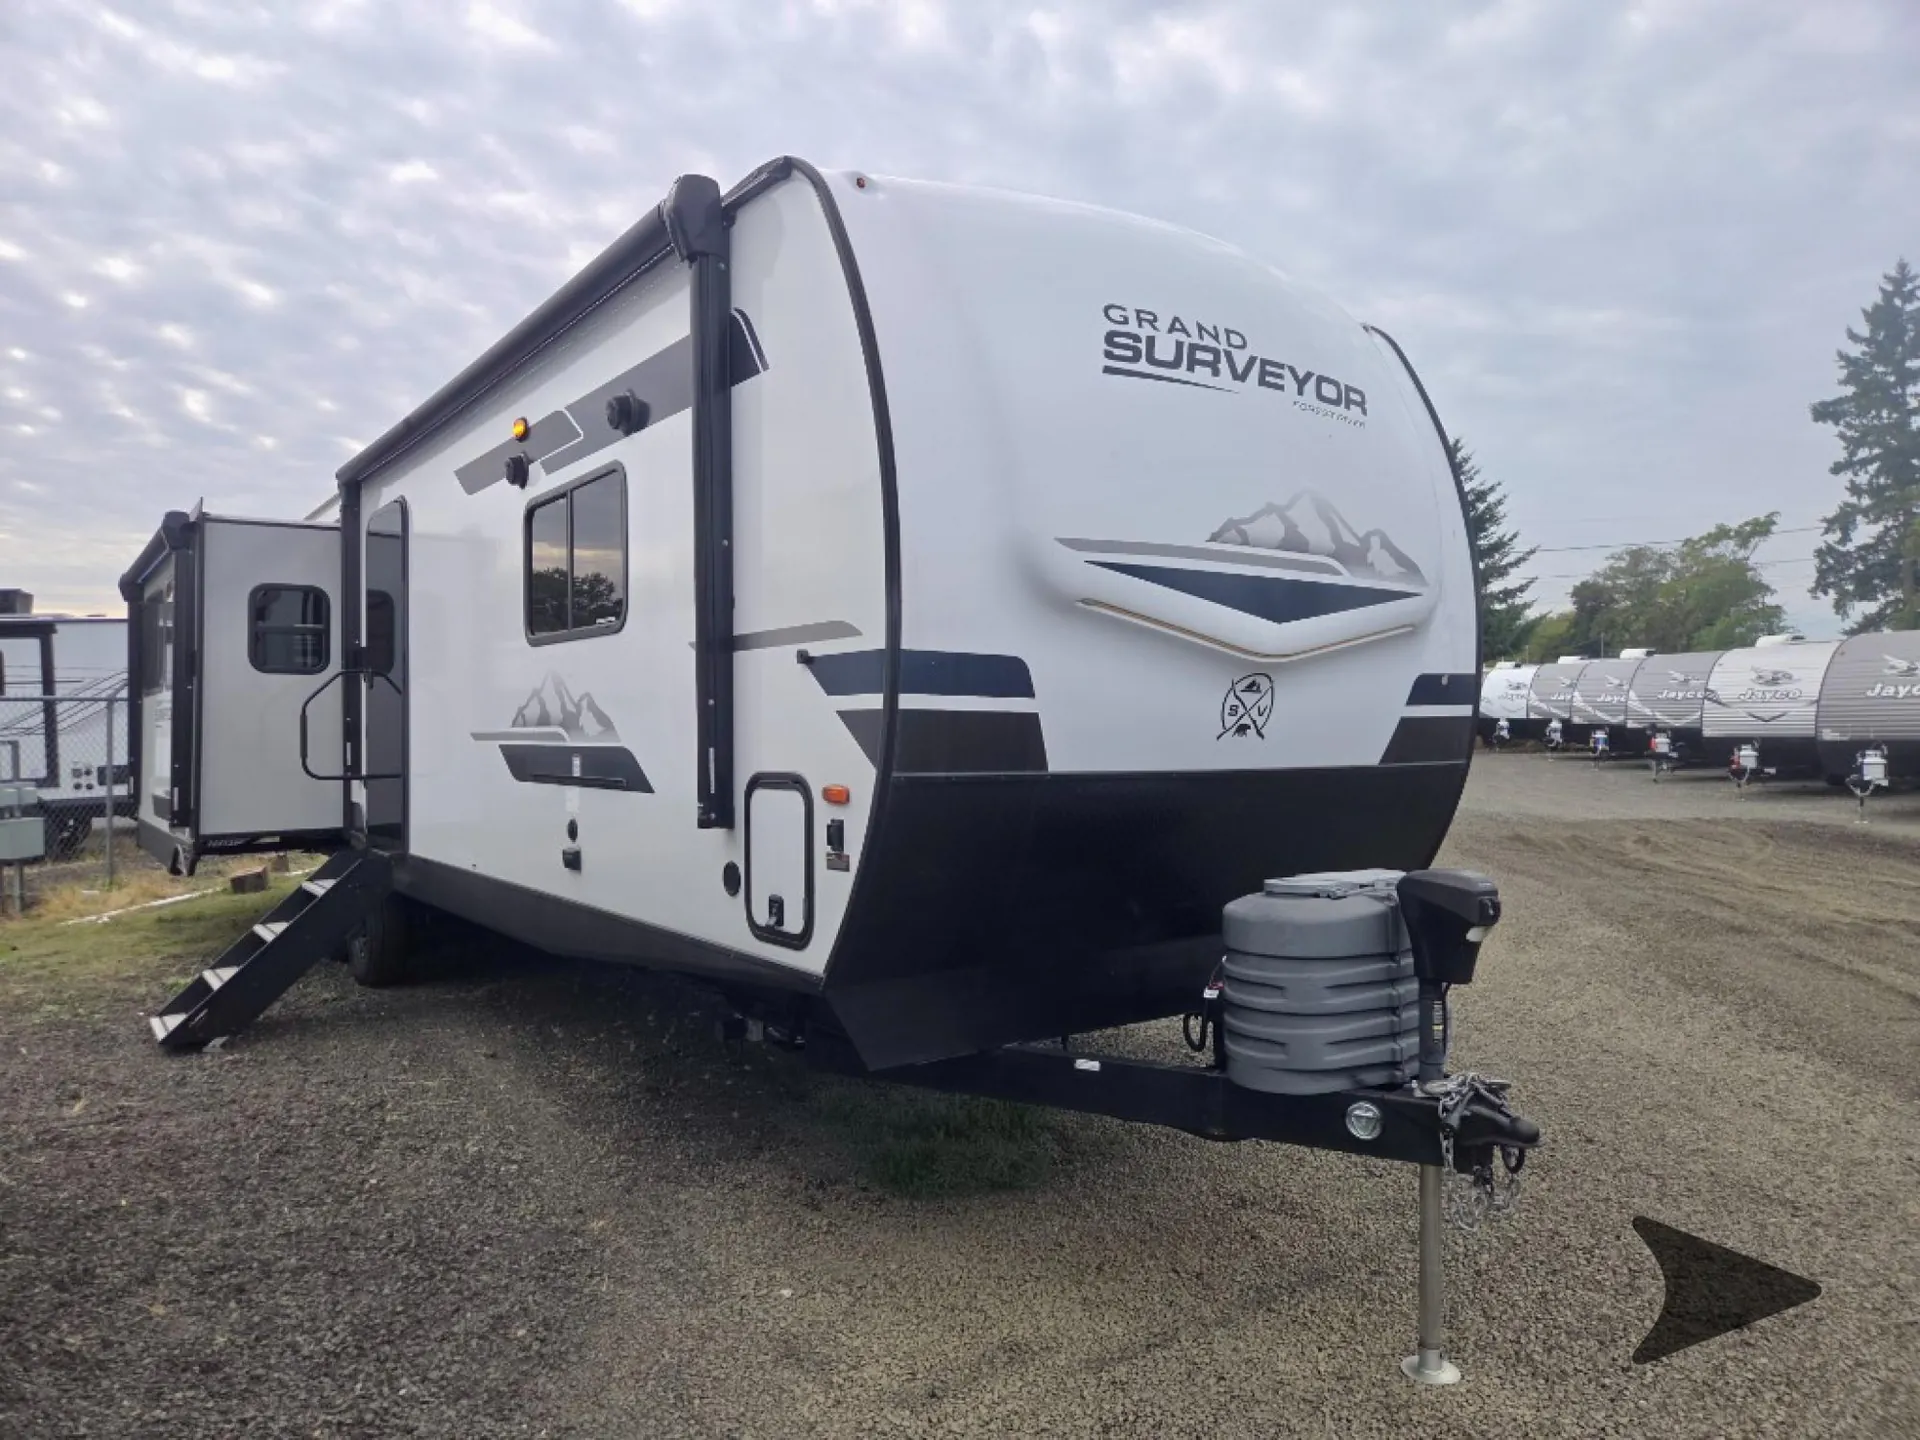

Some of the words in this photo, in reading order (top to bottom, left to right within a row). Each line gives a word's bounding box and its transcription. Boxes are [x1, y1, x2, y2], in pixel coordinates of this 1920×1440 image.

[1103, 303, 1247, 350] GRAND
[1104, 329, 1367, 417] SURVEYOR
[1737, 688, 1803, 702] Jayco
